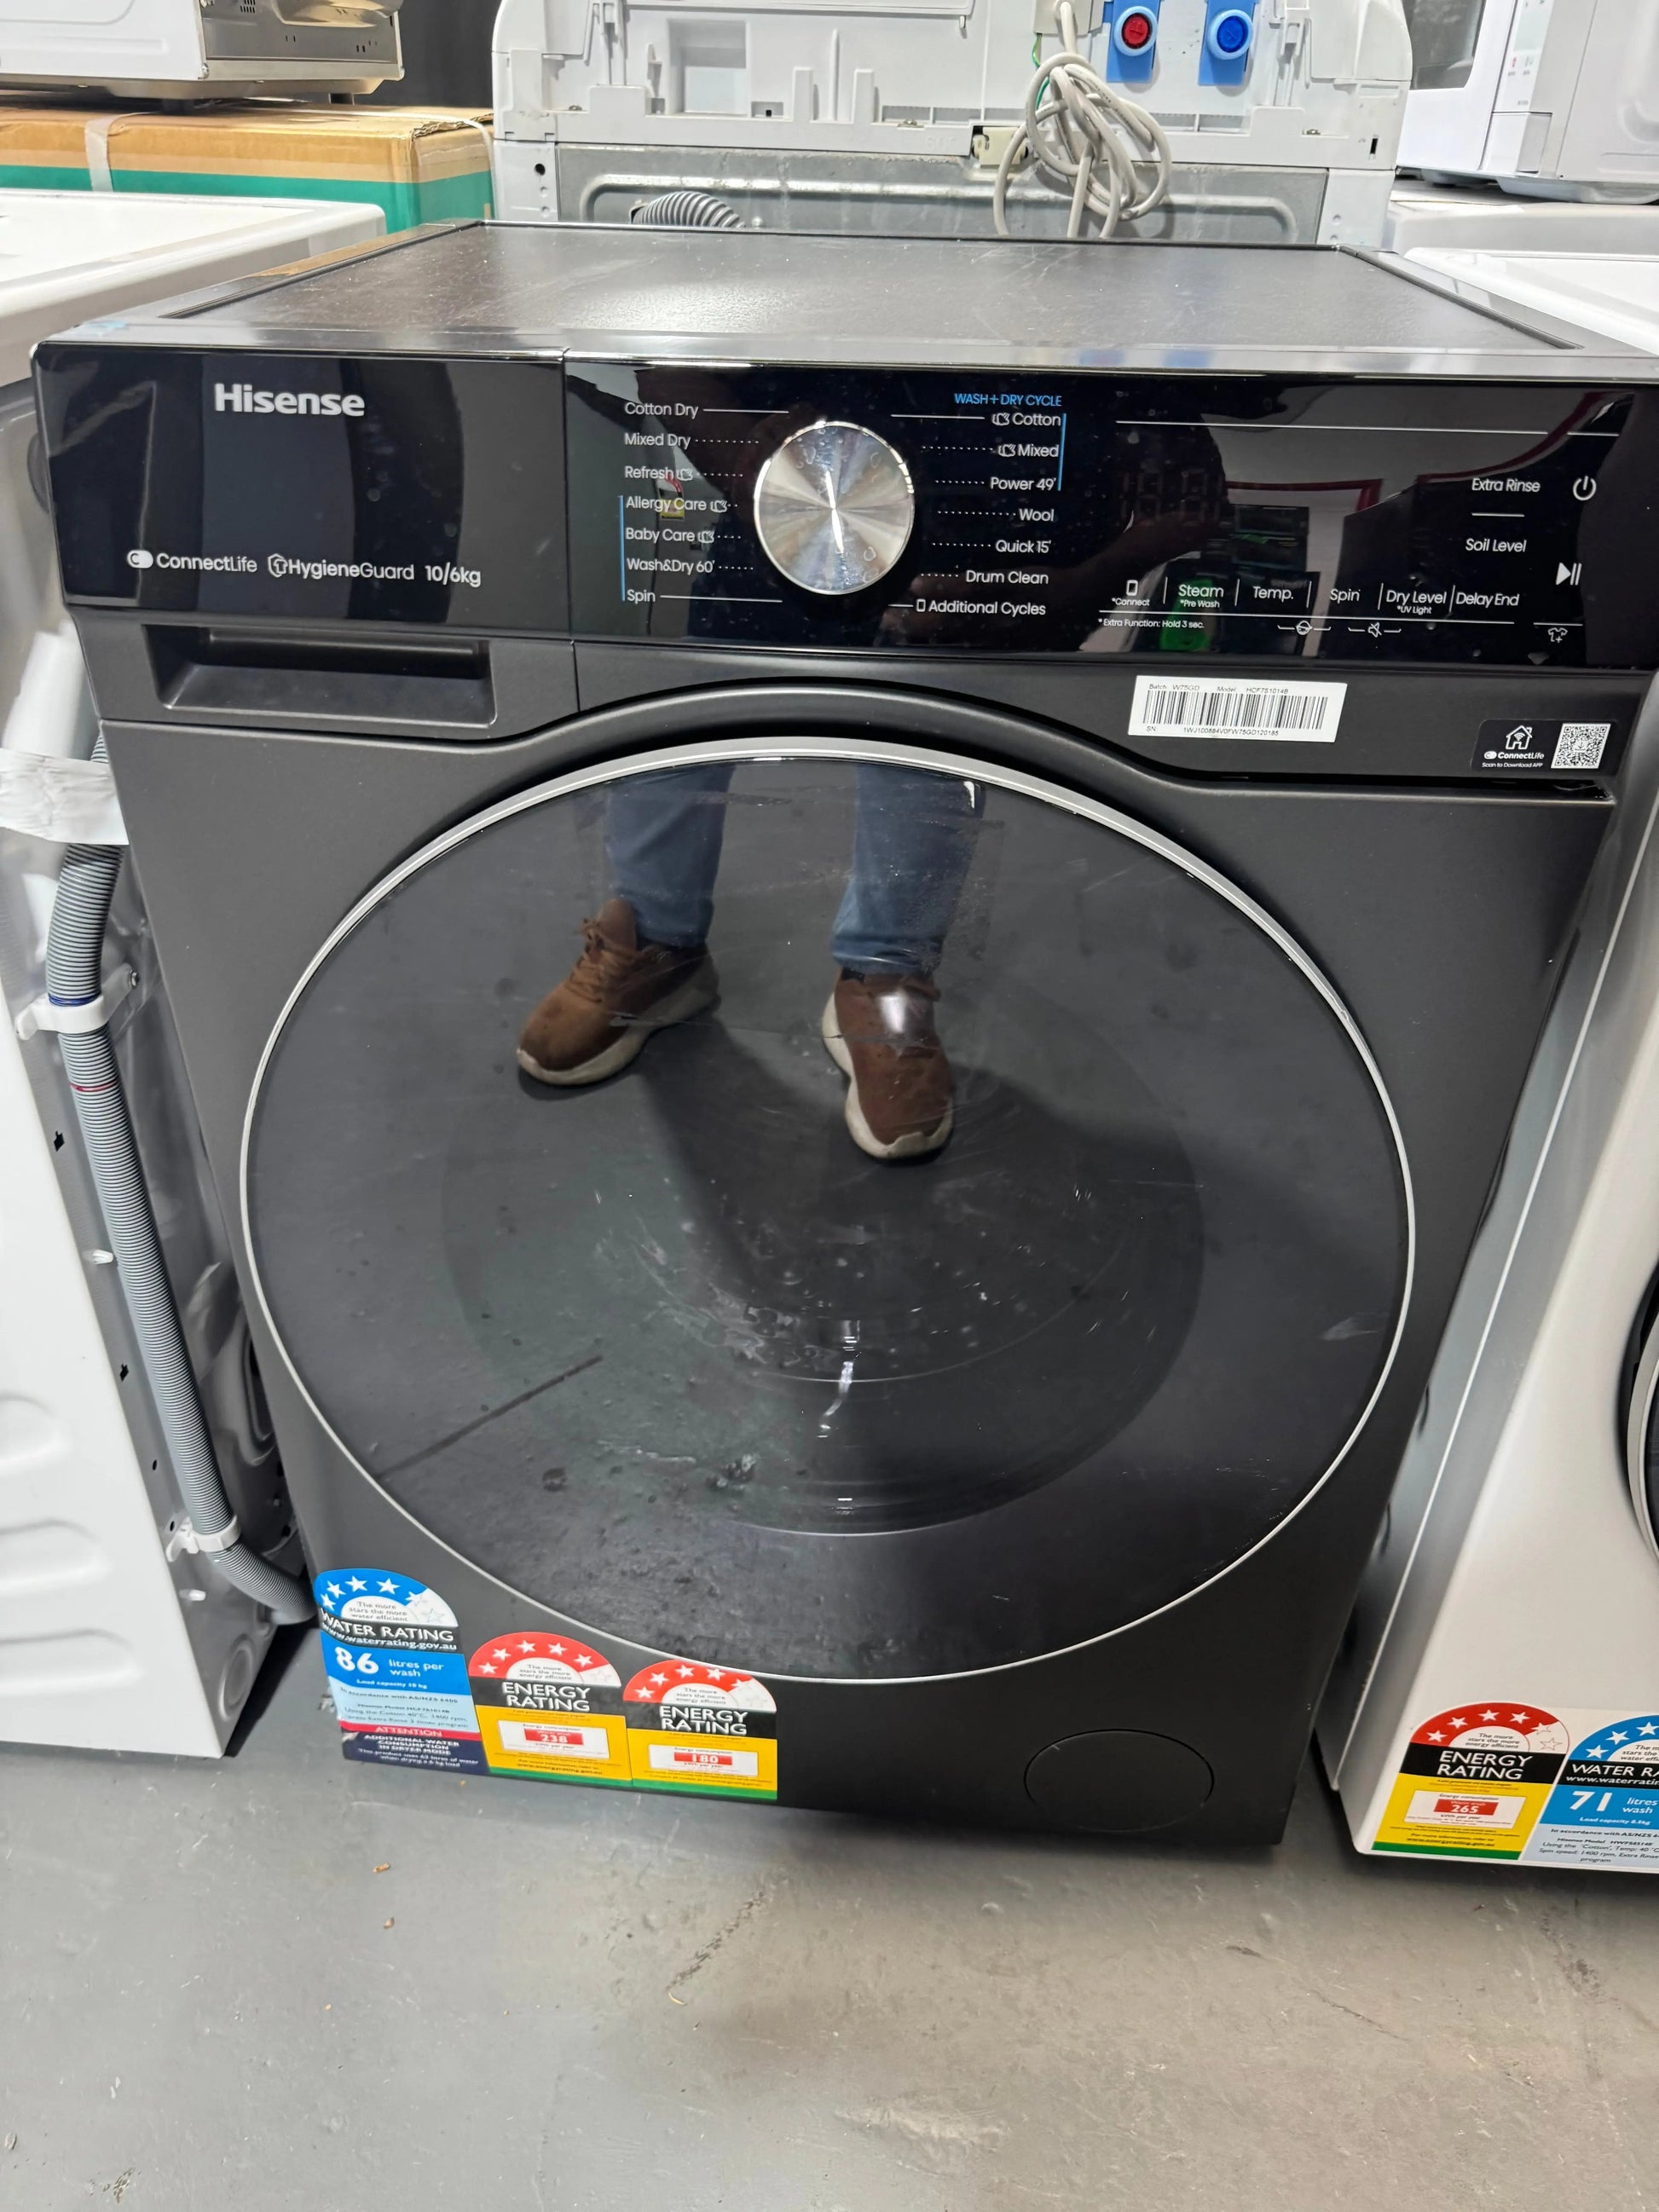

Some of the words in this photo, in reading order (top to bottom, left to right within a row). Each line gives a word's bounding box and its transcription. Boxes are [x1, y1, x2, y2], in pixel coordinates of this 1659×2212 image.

[215, 383, 365, 417] Hisense
[1026, 396, 1062, 407] CYCLE
[624, 401, 672, 416] Cotton
[675, 403, 699, 419] Dry
[1012, 413, 1061, 426] Cotton
[624, 432, 664, 446] Mixed
[667, 434, 691, 450] Dry
[1017, 444, 1060, 457] Mixed
[624, 465, 674, 479] Refresh
[990, 476, 1034, 490] Power
[1036, 477, 1057, 491] 49'
[1471, 477, 1504, 492] Extra
[1506, 478, 1541, 493] Rinse
[626, 495, 672, 512] Allergy
[673, 498, 708, 511] Care
[1018, 507, 1055, 522] Wool
[625, 527, 661, 544] Baby
[662, 528, 696, 542] Care
[995, 540, 1035, 553] Quick
[1037, 540, 1052, 553] 15'
[1465, 538, 1491, 552] Soil
[1492, 539, 1528, 553] Level
[156, 552, 257, 573] ConnectLife
[287, 558, 415, 580] HygieneGuard
[425, 561, 483, 588] 10/6kg
[626, 557, 694, 576] Wash&Dry
[696, 560, 716, 574] 60'
[965, 569, 1005, 583] Drum
[1008, 570, 1049, 585] Clean
[627, 589, 656, 604] Spin
[1178, 584, 1224, 598] Steam
[1253, 586, 1294, 600] Temp.
[1330, 588, 1361, 603] Spin
[1385, 590, 1413, 606] Dry
[1412, 591, 1448, 604] Level
[1197, 600, 1220, 609] Wash
[1455, 592, 1494, 609] Delay
[1494, 593, 1520, 607] End
[928, 599, 998, 615] Additional
[1000, 602, 1047, 618] Cycles
[1412, 605, 1432, 615] Light
[1124, 619, 1161, 628] Function:
[1161, 620, 1181, 628] Hold
[1497, 752, 1545, 760] ConnectLife
[321, 1607, 377, 1636] WATER
[381, 1626, 455, 1643] RATING
[334, 1646, 379, 1675] 86
[389, 1658, 420, 1669] litres
[423, 1663, 444, 1673] per
[390, 1668, 422, 1678] wash
[501, 1682, 590, 1700] ENERGY
[506, 1695, 590, 1712] RATING
[660, 1705, 749, 1724] ENERGY
[375, 1726, 442, 1737] ATTENTION
[661, 1718, 748, 1736] RATING
[364, 1734, 425, 1744] ADDITIONAL
[378, 1740, 449, 1750] CONSUMPTION
[540, 1734, 568, 1744] 238
[692, 1753, 719, 1764] 180
[1439, 1750, 1533, 1767] ENERGY
[1436, 1764, 1524, 1780] RATING
[1572, 1764, 1635, 1776] WATER
[1569, 1791, 1613, 1812] 71
[1450, 1805, 1479, 1814] 265
